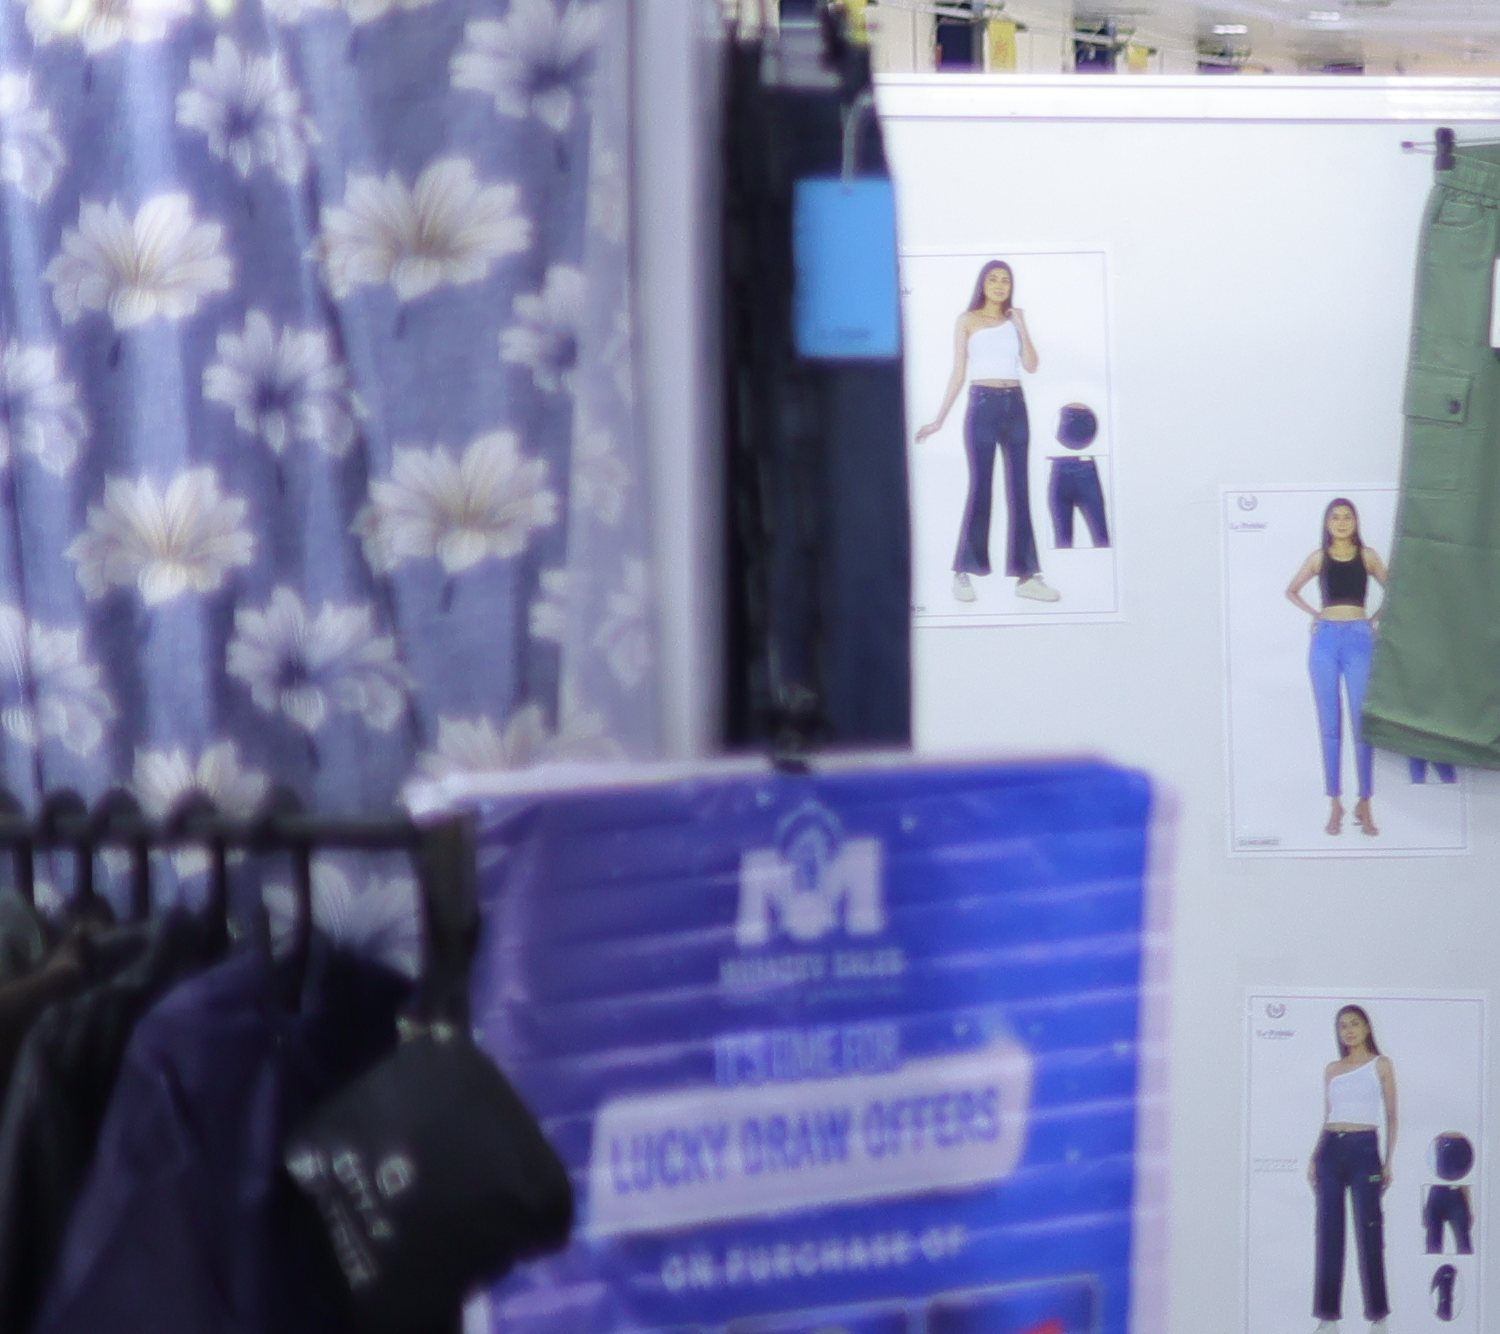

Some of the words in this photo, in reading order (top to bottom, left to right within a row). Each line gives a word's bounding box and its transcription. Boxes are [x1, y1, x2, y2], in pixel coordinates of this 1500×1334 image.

[610, 1123, 728, 1195] LUCKY
[741, 1106, 853, 1176] DRAW
[862, 1085, 999, 1160] OFFERS
